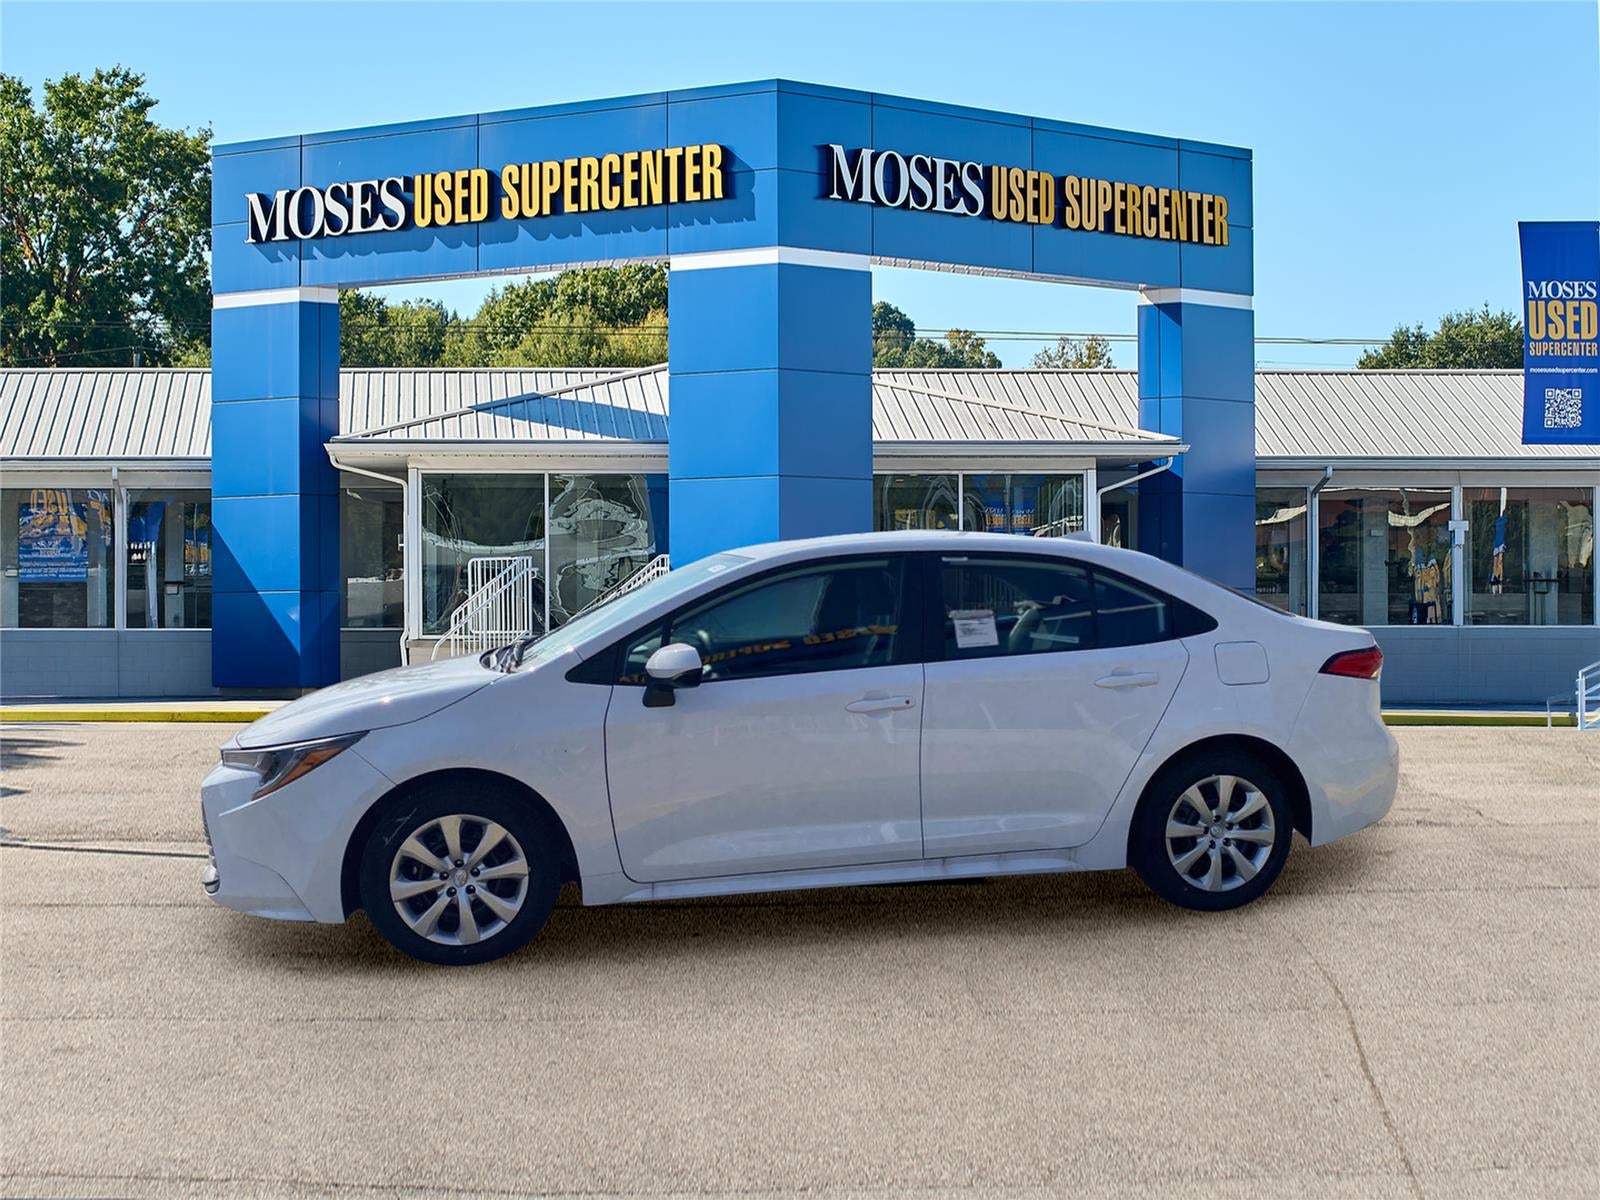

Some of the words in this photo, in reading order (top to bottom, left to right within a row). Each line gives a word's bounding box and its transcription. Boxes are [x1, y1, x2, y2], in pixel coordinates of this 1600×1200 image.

[244, 177, 410, 244] MOSES
[413, 168, 488, 228] USED
[500, 143, 724, 220] SUPERCENTER
[829, 143, 985, 217] MOSES
[991, 165, 1056, 225] USED
[1065, 174, 1230, 247] SUPERCENTER
[1528, 280, 1597, 299] MOSES
[1528, 300, 1598, 340] USED
[1529, 341, 1598, 357] SUPERCENTER
